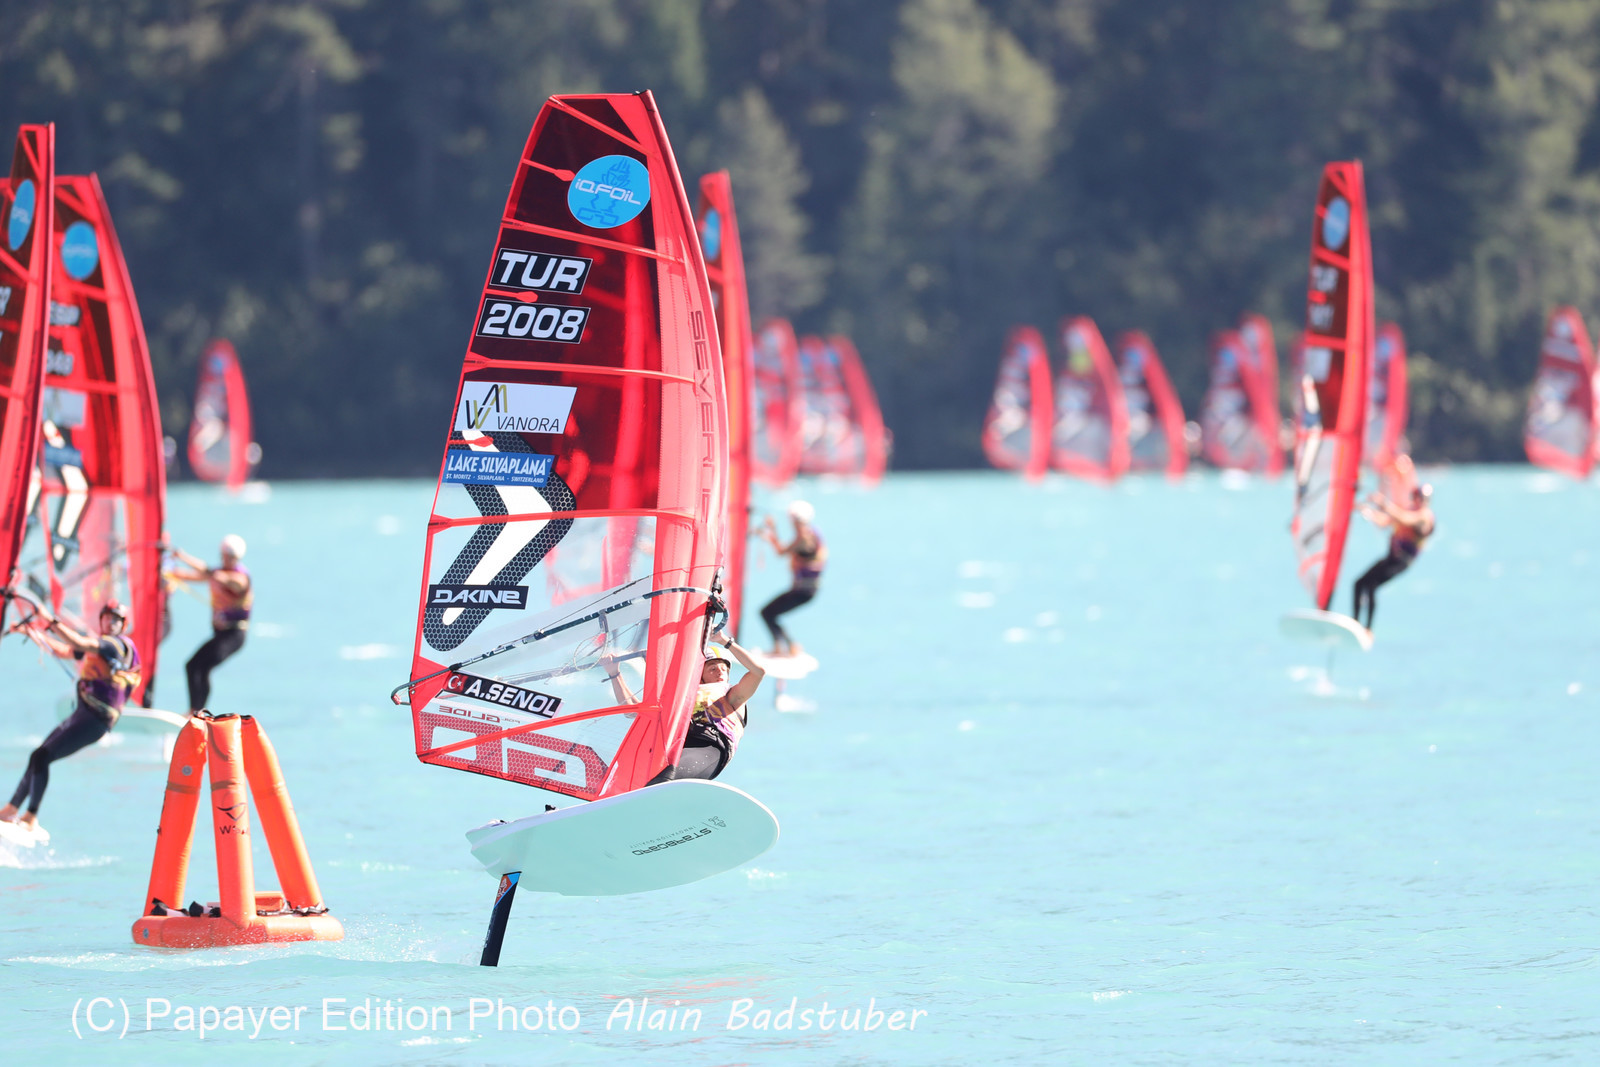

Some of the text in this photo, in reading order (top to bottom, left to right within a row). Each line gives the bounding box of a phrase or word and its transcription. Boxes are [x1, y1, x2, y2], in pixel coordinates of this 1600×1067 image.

[500, 252, 586, 291] TUR
[482, 303, 585, 341] 2008
[497, 416, 559, 432] VANORA
[447, 454, 546, 477] LAKE SILVAPLANA
